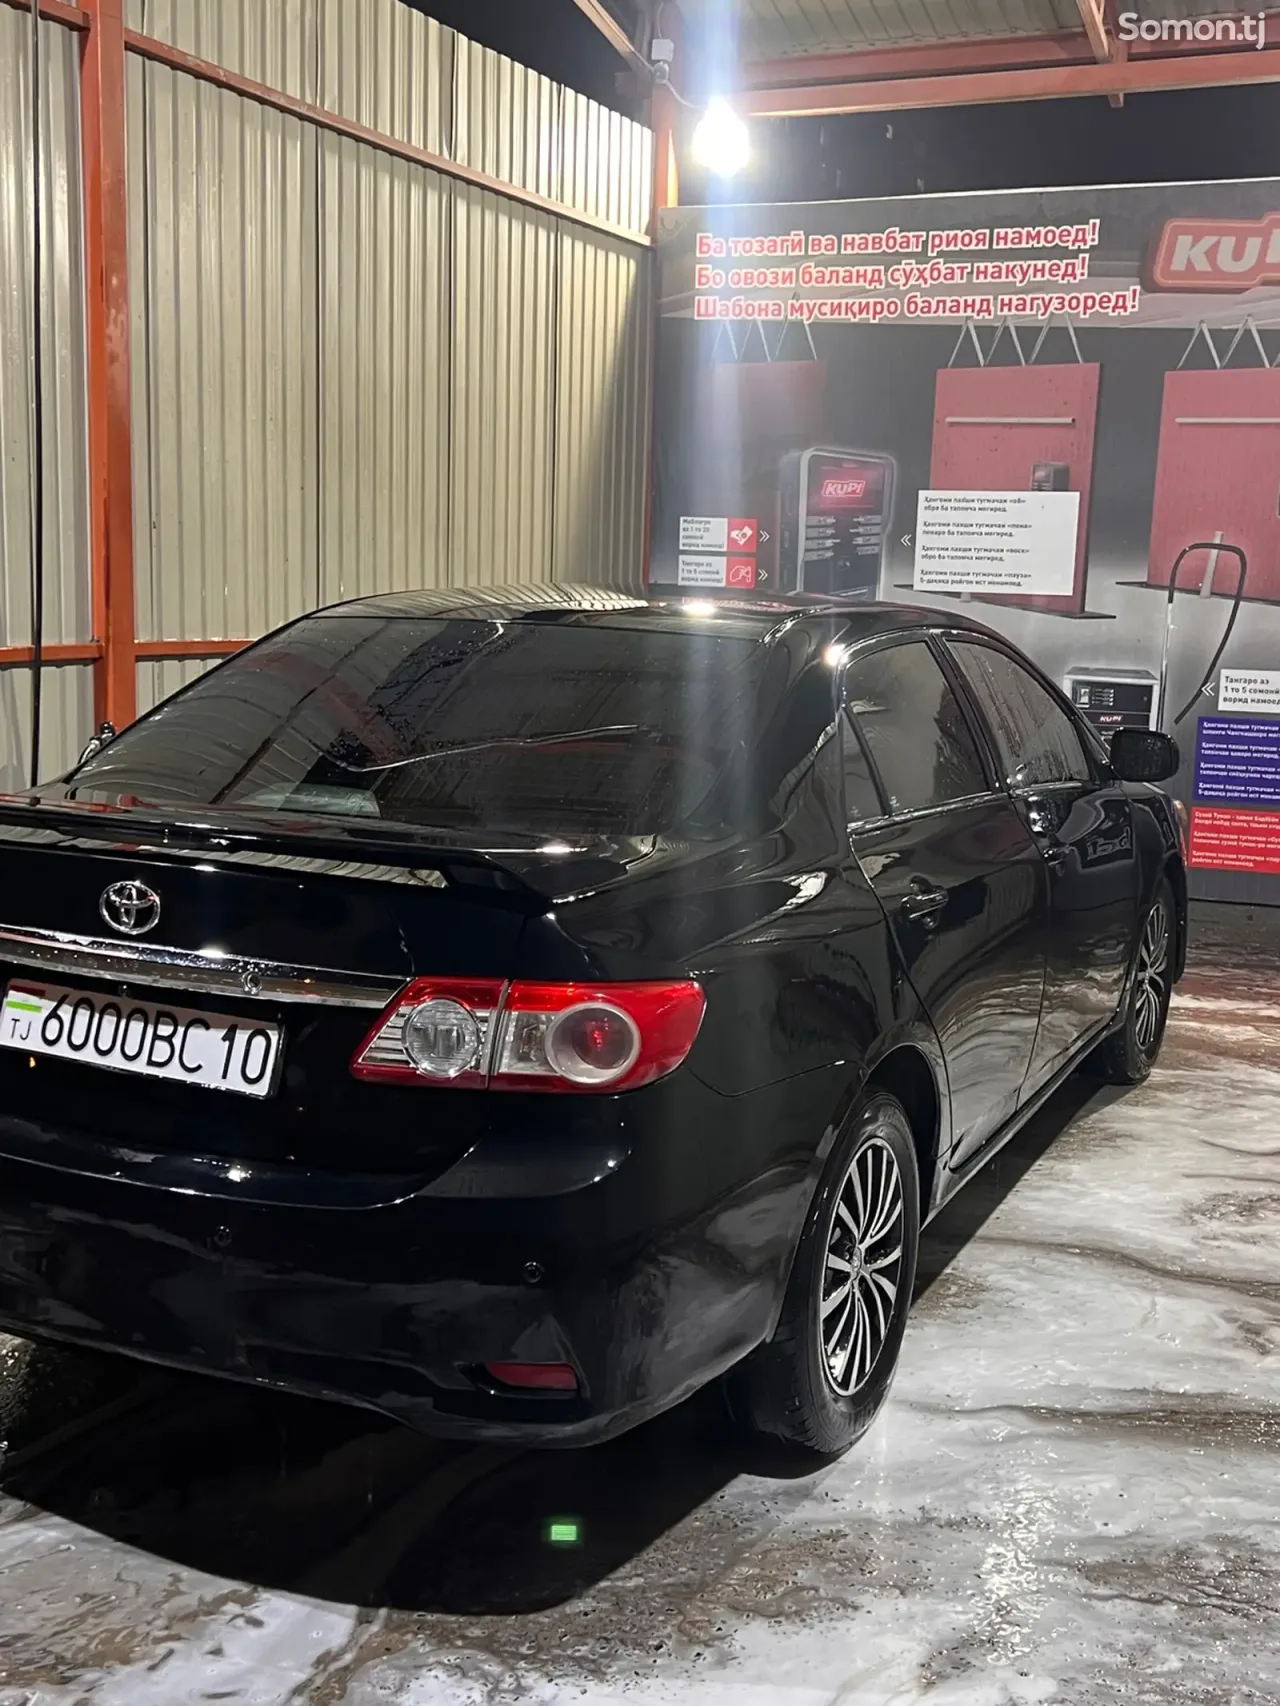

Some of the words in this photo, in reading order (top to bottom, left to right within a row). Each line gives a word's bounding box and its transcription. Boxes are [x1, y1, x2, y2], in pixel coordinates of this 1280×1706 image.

[697, 233, 725, 257] Ба
[730, 231, 804, 256] тозагӣ
[808, 235, 837, 255] ва
[841, 227, 925, 254] навбат
[928, 229, 989, 256] риоя
[993, 219, 1100, 249] намоед!
[696, 264, 725, 288] Бо
[728, 268, 795, 288] овози
[800, 263, 885, 288] баланд
[888, 259, 970, 289] сӯҳбат
[973, 254, 1089, 286] накунед!
[695, 296, 784, 319] Шабона
[788, 299, 900, 323] мусиқиро
[904, 292, 995, 318] баланд
[998, 286, 1140, 319] нагузоред!
[825, 482, 864, 496] KUPI
[1225, 676, 1258, 685] Тангаро
[10, 1018, 32, 1041] TJ
